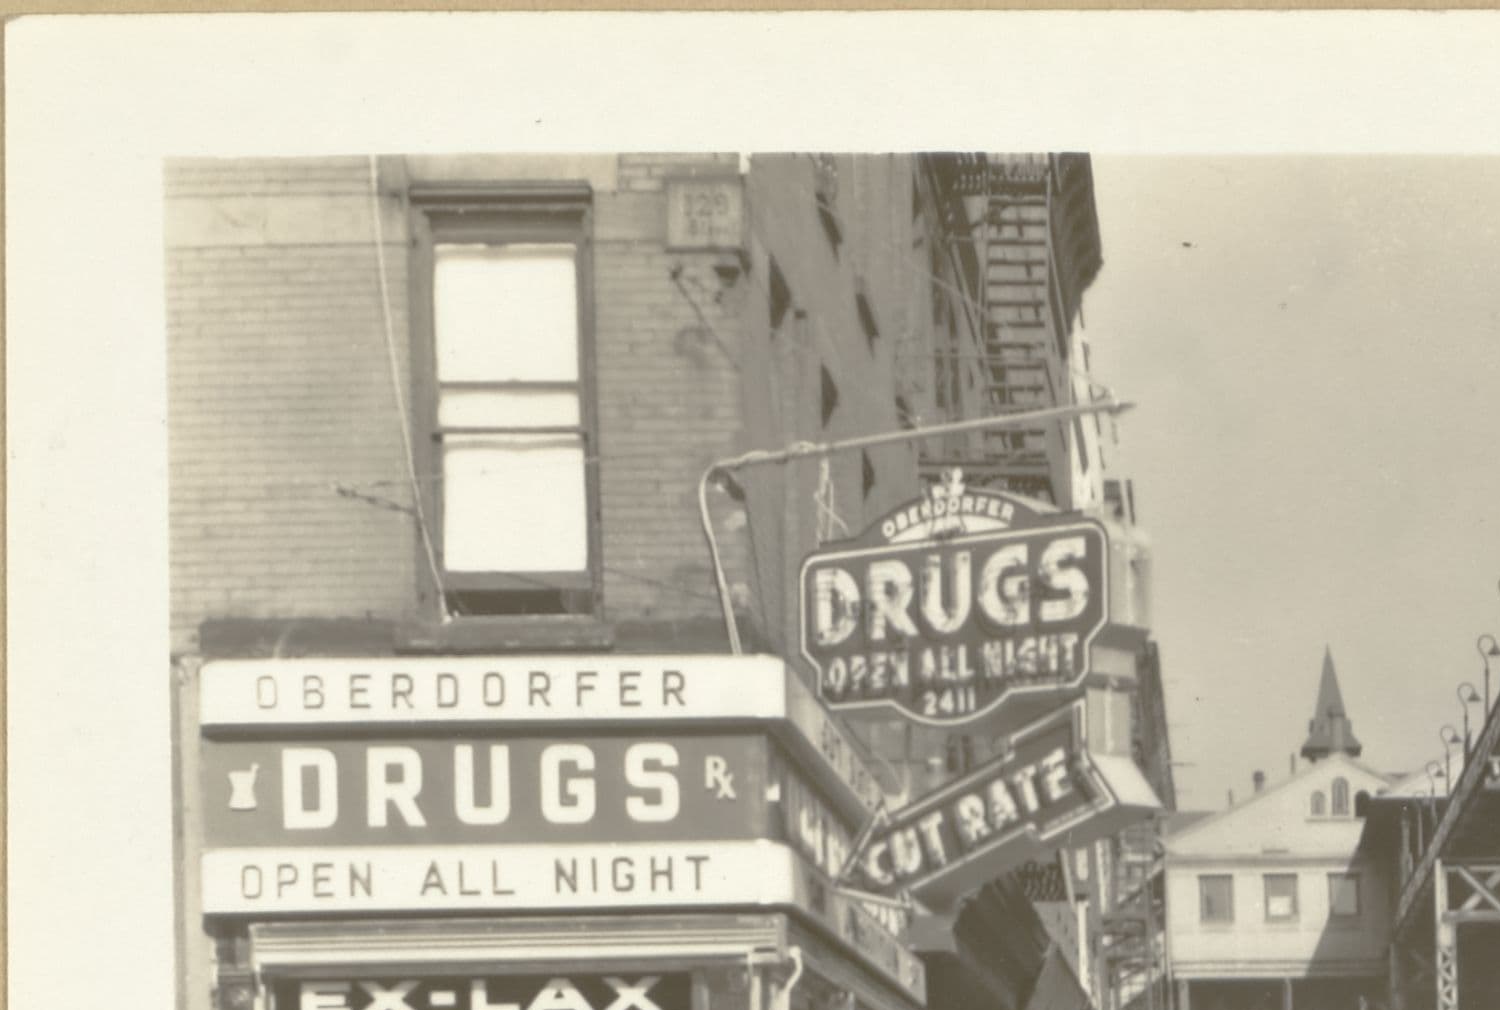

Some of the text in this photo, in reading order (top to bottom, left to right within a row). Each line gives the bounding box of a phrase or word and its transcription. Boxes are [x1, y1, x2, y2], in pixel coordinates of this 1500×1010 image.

[814, 537, 1090, 646] DRUGS
[256, 670, 686, 710] OBERDORFER
[828, 633, 1080, 691] OPEN ALL NIGHT
[923, 686, 976, 716] 2411
[281, 743, 680, 830] DRUGS
[865, 810, 947, 885] CUT
[958, 747, 1074, 842] RATE
[241, 856, 710, 900] OPEN ALL NIGHT
